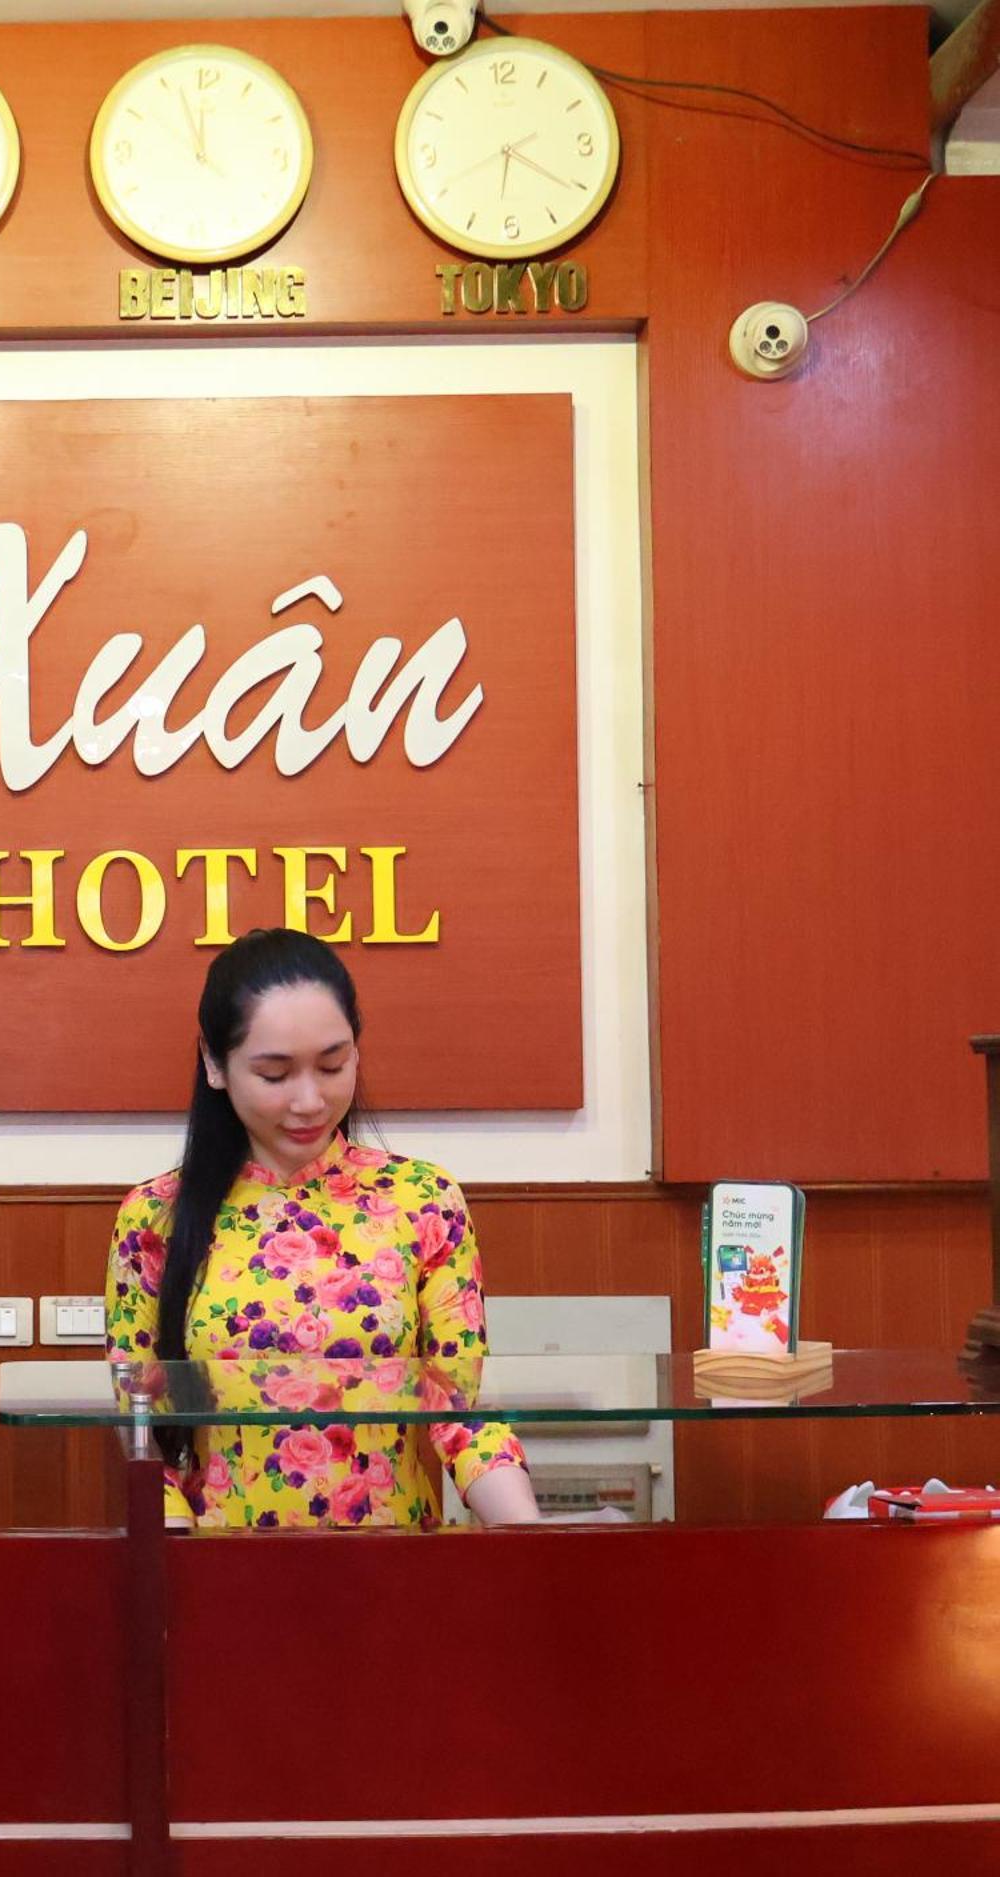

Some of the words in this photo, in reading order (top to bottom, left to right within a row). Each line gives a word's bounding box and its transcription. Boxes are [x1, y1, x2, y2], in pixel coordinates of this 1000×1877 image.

[489, 61, 516, 84] 12
[577, 132, 593, 157] 3
[119, 265, 307, 320] BEIJING
[435, 262, 587, 314] TOKYO
